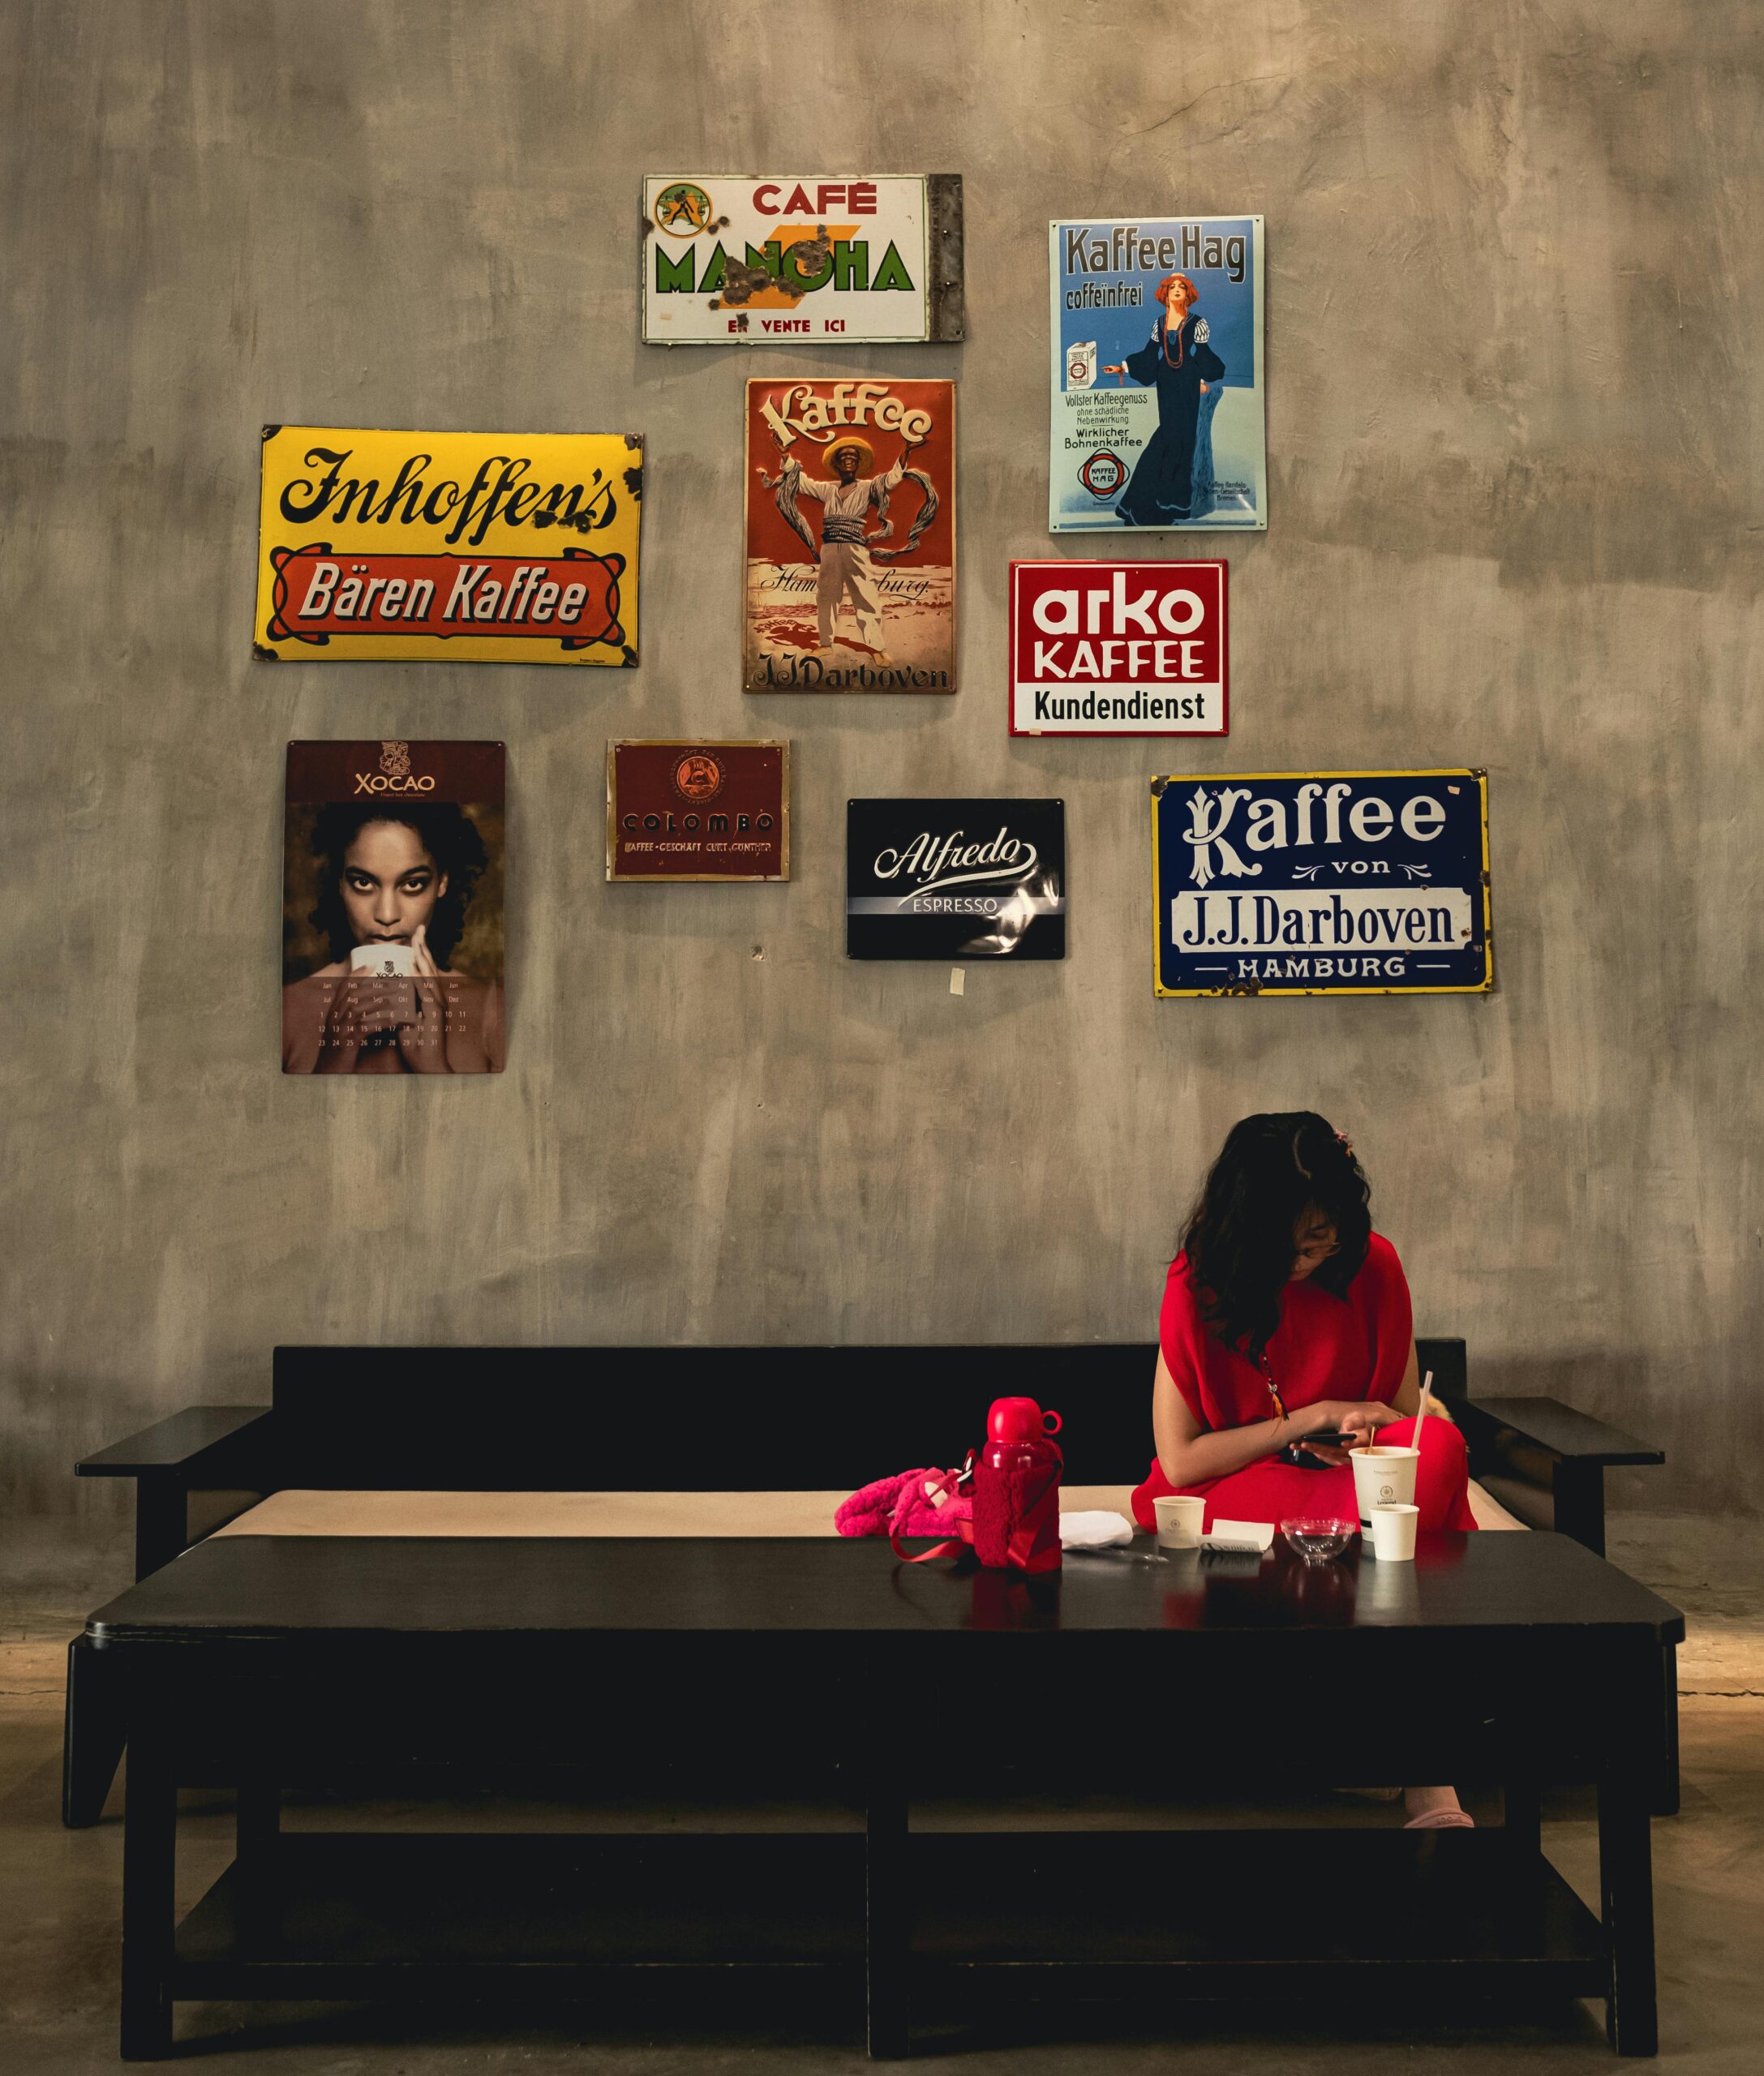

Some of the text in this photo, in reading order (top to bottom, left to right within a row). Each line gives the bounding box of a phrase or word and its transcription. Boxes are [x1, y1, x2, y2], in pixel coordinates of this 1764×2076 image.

[753, 182, 877, 215] CAFÉ
[1066, 225, 1247, 284] Kaffee Hag
[761, 320, 810, 332] VENTE
[825, 320, 845, 332] ICI
[1065, 392, 1148, 407] Vollster Kaffeegenuss
[1077, 406, 1129, 416] ohne schädliche
[759, 384, 932, 446] Kaffee
[1065, 437, 1143, 448] Bohnenkaffee
[1076, 427, 1130, 438] Wirklicher
[280, 448, 617, 546] Inhoffen's
[298, 562, 589, 624] Bären Kaffee
[1032, 572, 1205, 635] arko
[1034, 640, 1205, 678] KAFFEE
[1035, 690, 1205, 720] Kundendienst
[354, 773, 436, 795] XOCAO
[623, 813, 774, 832] COLOMBO
[1182, 783, 1446, 890] Kaffee
[873, 826, 1024, 883] Alfredo
[1331, 860, 1391, 874] von
[913, 899, 998, 912] ESPRESSO
[1238, 956, 1406, 978] HAMBURG
